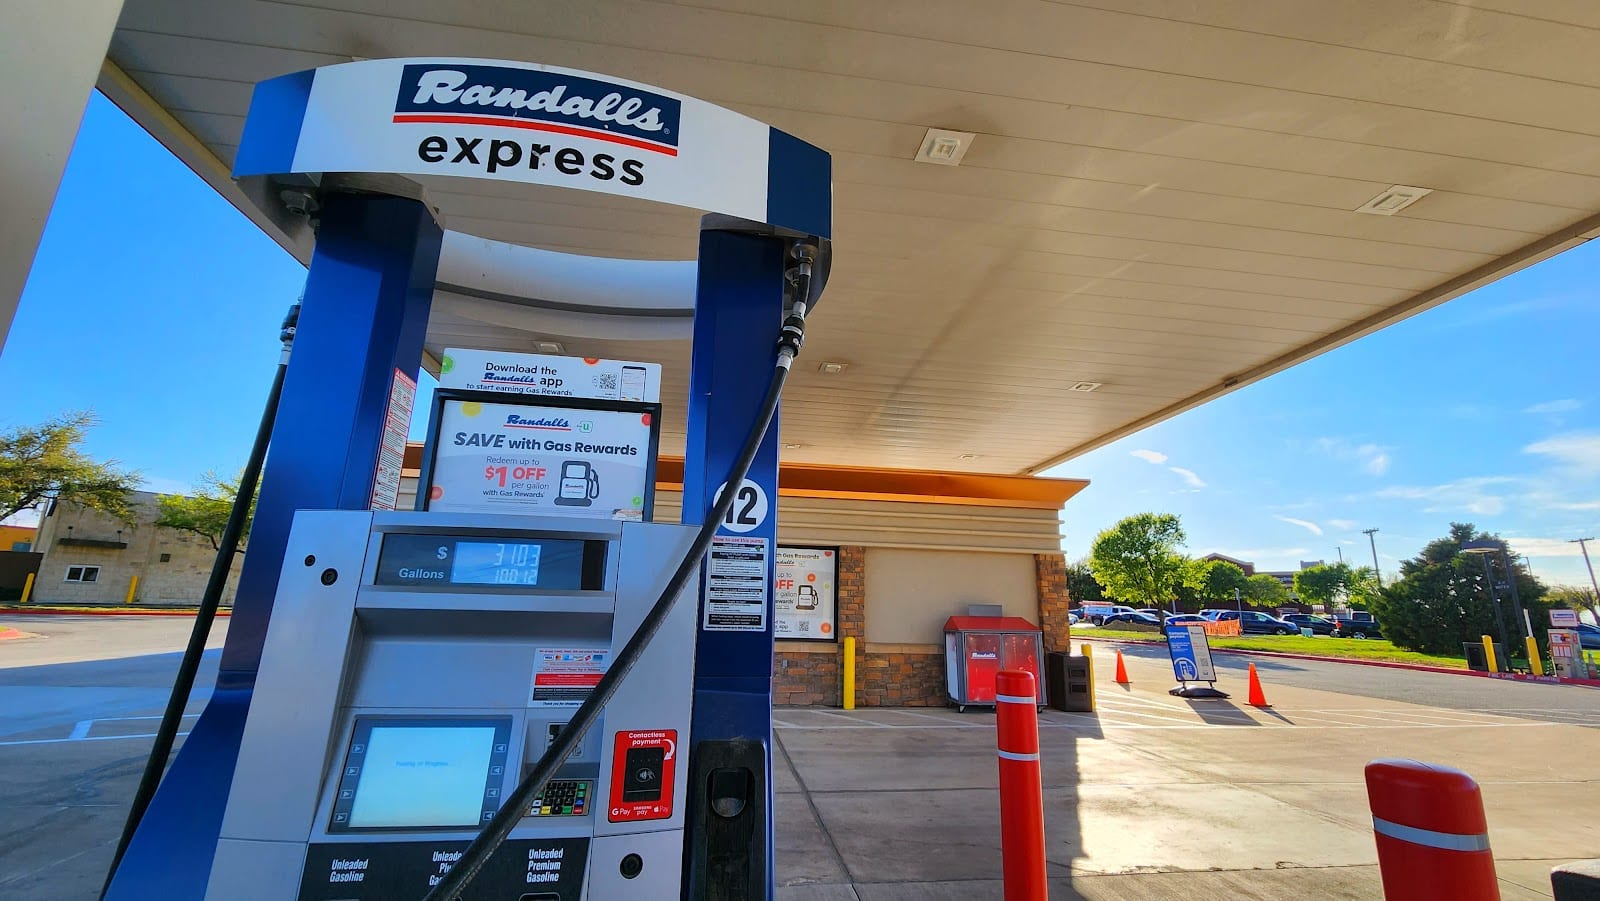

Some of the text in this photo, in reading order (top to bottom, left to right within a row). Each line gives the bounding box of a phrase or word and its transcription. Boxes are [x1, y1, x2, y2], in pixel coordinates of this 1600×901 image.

[412, 69, 665, 131] Randalls
[418, 135, 645, 187] express
[485, 362, 557, 375] Download the
[483, 372, 563, 388] Randalls app
[496, 385, 524, 394] earning
[506, 414, 569, 428] Randalls
[454, 432, 638, 456] SAVE with Gas Rewards
[486, 456, 518, 465] Redeem
[520, 458, 530, 466] up
[485, 465, 546, 488] $1 OFF
[526, 482, 550, 491] gallon
[436, 546, 448, 560] $
[399, 568, 444, 579] Gallons
[632, 738, 661, 746] payment
[620, 807, 631, 817] Pay
[432, 851, 463, 862] Unleade
[528, 848, 564, 860] Unleaded
[331, 858, 369, 870] Unleaded
[527, 860, 561, 872] Premium
[329, 871, 365, 882] Gasoline
[526, 871, 560, 883] Gasoline
